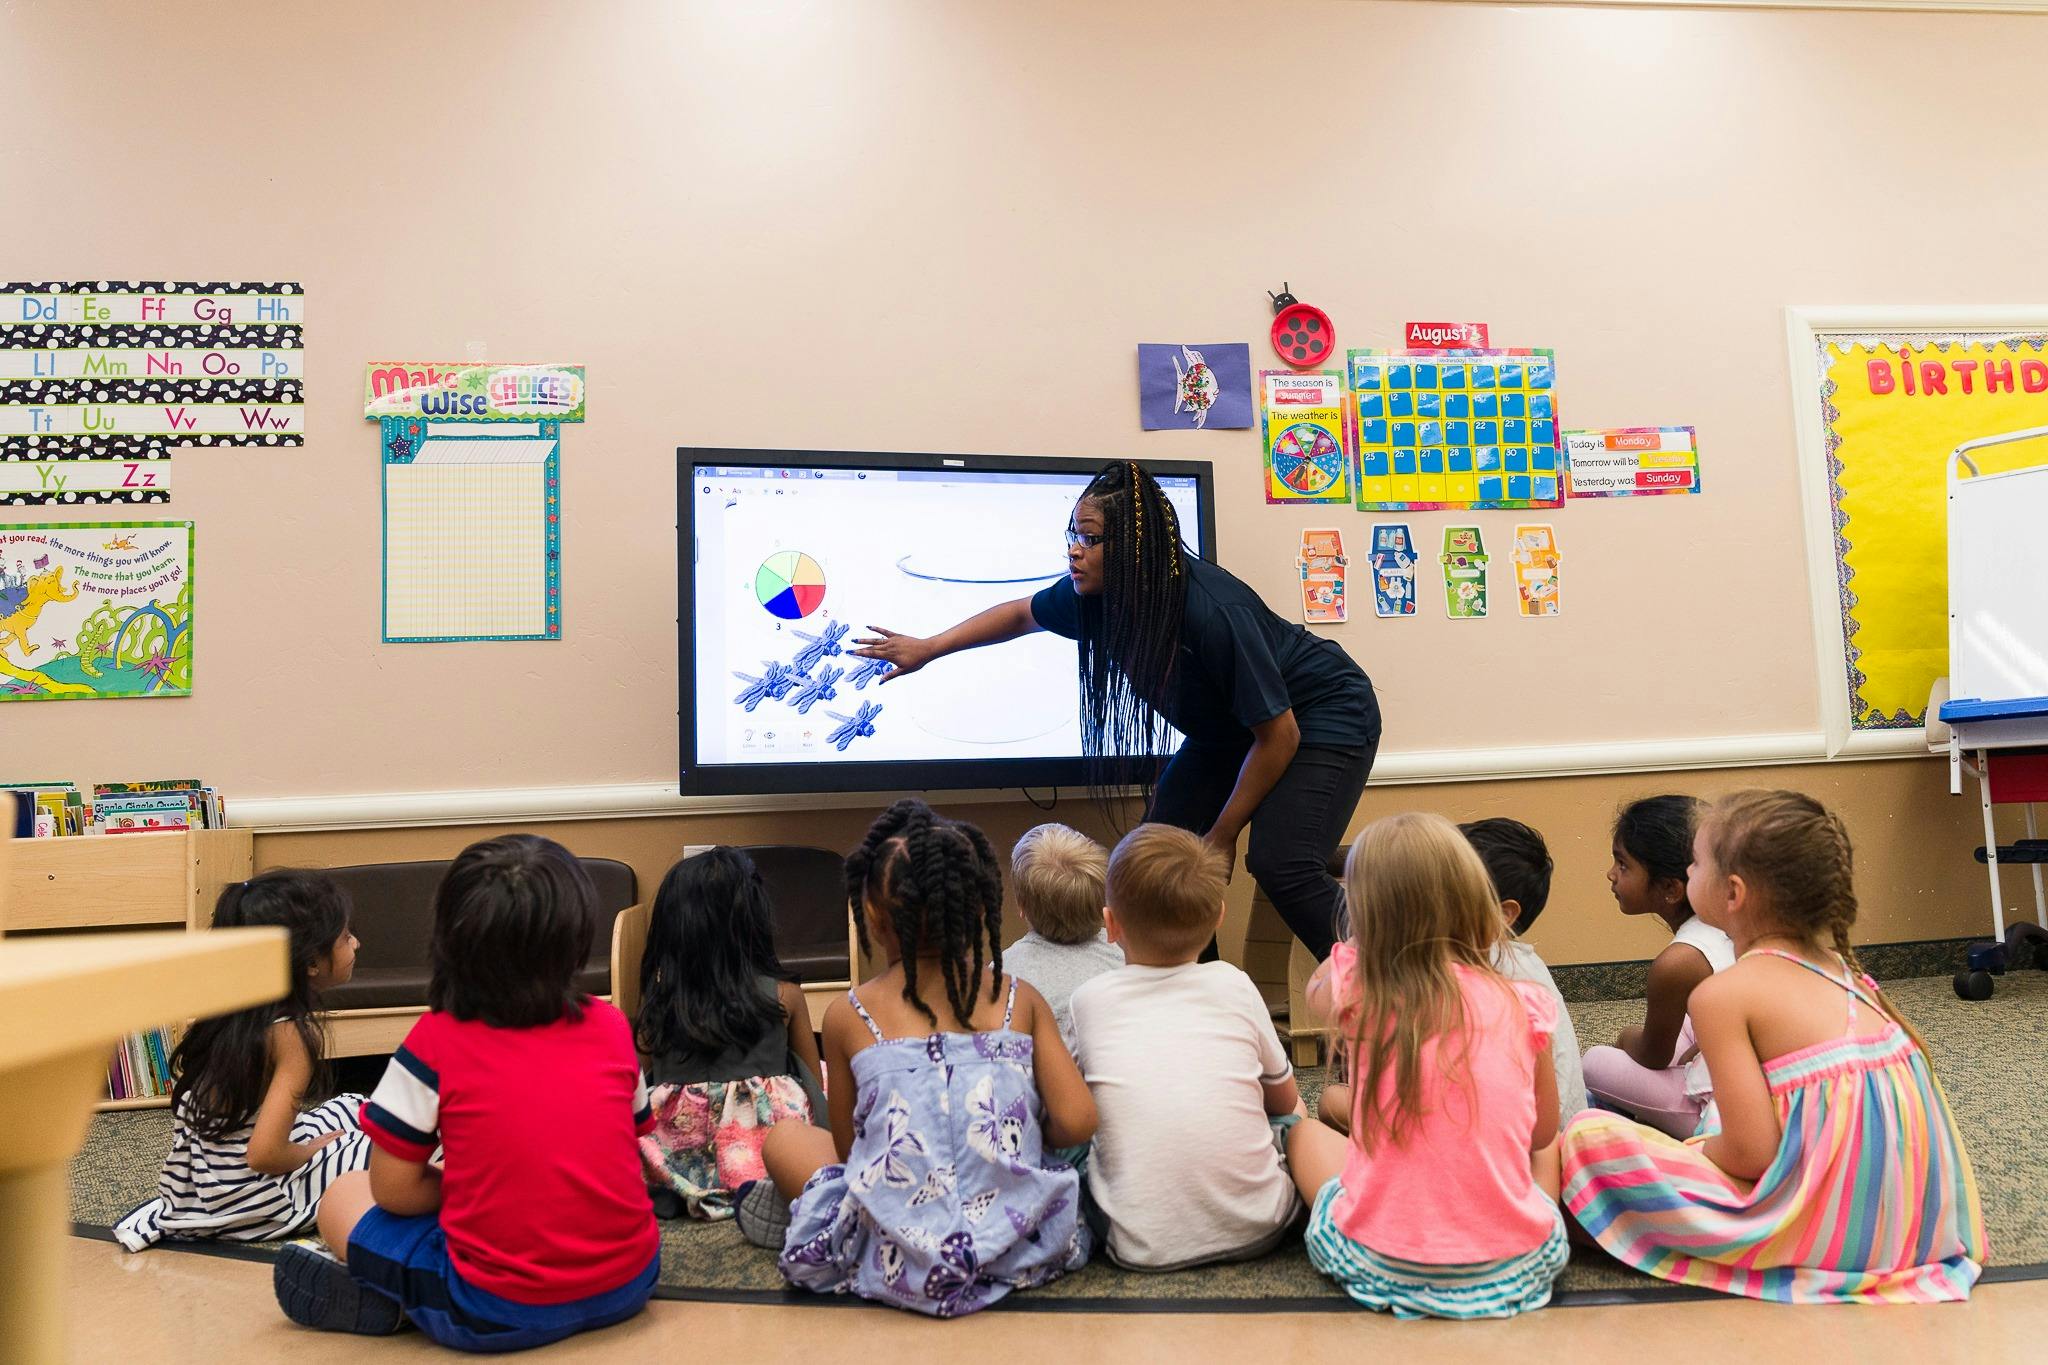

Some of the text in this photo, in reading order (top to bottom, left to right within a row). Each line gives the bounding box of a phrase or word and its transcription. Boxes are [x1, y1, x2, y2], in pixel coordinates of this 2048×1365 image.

[22, 297, 290, 326] Dd Ee Ff Gg Hh
[1410, 324, 1468, 346] August
[82, 353, 128, 376] Mm
[146, 352, 183, 375] Nn
[202, 352, 240, 376] Oo
[261, 352, 289, 379] Pp
[1529, 366, 1539, 374] 10
[1273, 379, 1289, 387] The
[1326, 379, 1333, 387] is
[1446, 394, 1454, 402] 14
[1502, 394, 1510, 402] 16
[29, 407, 290, 431] Tt Uu Vv Ww
[1272, 411, 1338, 420] The weather is
[1365, 419, 1373, 427] 18
[1393, 423, 1401, 431] 19
[1447, 421, 1455, 430] 21
[1475, 421, 1486, 430] 22
[1504, 419, 1515, 428] 23
[1532, 420, 1543, 428] 24
[1570, 437, 1652, 450] Today is Monday
[1365, 453, 1375, 461] 25
[1395, 450, 1405, 458] 26
[1421, 449, 1431, 457] 27
[1449, 448, 1459, 456] 28
[1506, 448, 1517, 456] 30
[1532, 446, 1540, 454] 31
[1571, 458, 1611, 468] Tomorrow
[1612, 458, 1627, 466] will
[1628, 456, 1639, 465] be
[36, 463, 156, 498] Yy Zz
[1510, 475, 1516, 483] 2
[1573, 473, 1681, 487] Yesterday was Sunday
[9, 535, 25, 544] you
[49, 537, 64, 550] the
[64, 545, 85, 558] more
[87, 551, 113, 568] things
[116, 558, 132, 568] you
[134, 552, 149, 564] will
[75, 565, 90, 577] The
[91, 571, 113, 580] more
[115, 571, 134, 581] that
[136, 569, 152, 581] you
[82, 581, 96, 592] the
[98, 586, 119, 596] more
[120, 584, 148, 598] places
[170, 564, 183, 582] go!
[822, 609, 828, 617] 2
[776, 622, 781, 631] 3
